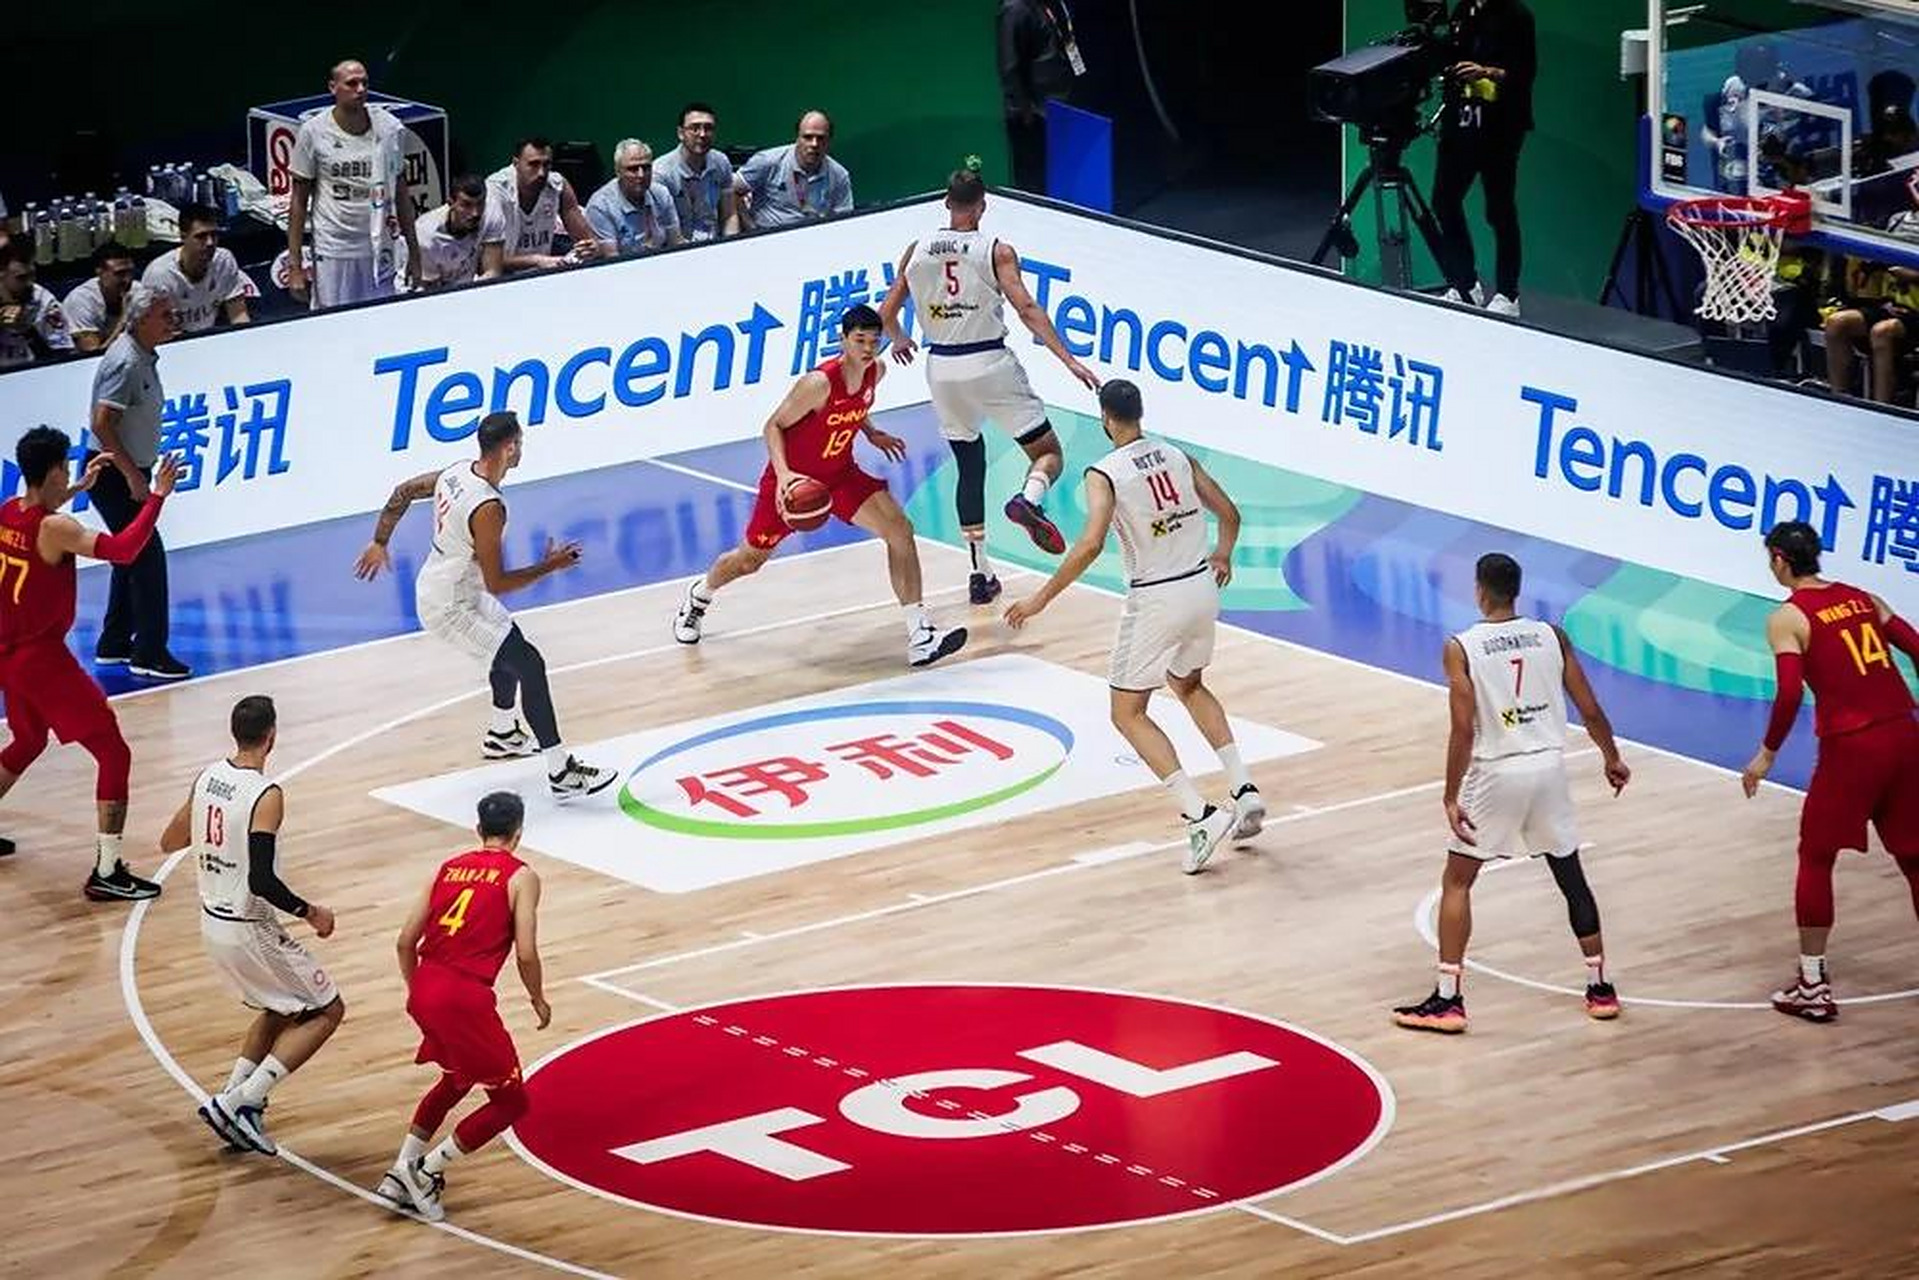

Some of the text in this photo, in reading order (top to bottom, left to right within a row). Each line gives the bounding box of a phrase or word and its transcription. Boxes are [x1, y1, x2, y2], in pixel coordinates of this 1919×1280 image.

[944, 260, 960, 296] 5
[373, 302, 784, 452] Tencent
[1018, 256, 1445, 451] Tencent 腾讯
[822, 429, 853, 459] 19
[1520, 385, 1856, 553] Tencent
[1146, 470, 1181, 512] 14
[1840, 622, 1890, 677] 14
[1509, 657, 1524, 699] 7
[675, 720, 1014, 818] 伊利
[205, 804, 224, 848] 13
[438, 888, 476, 937] 4
[607, 1040, 1282, 1181] TCL
